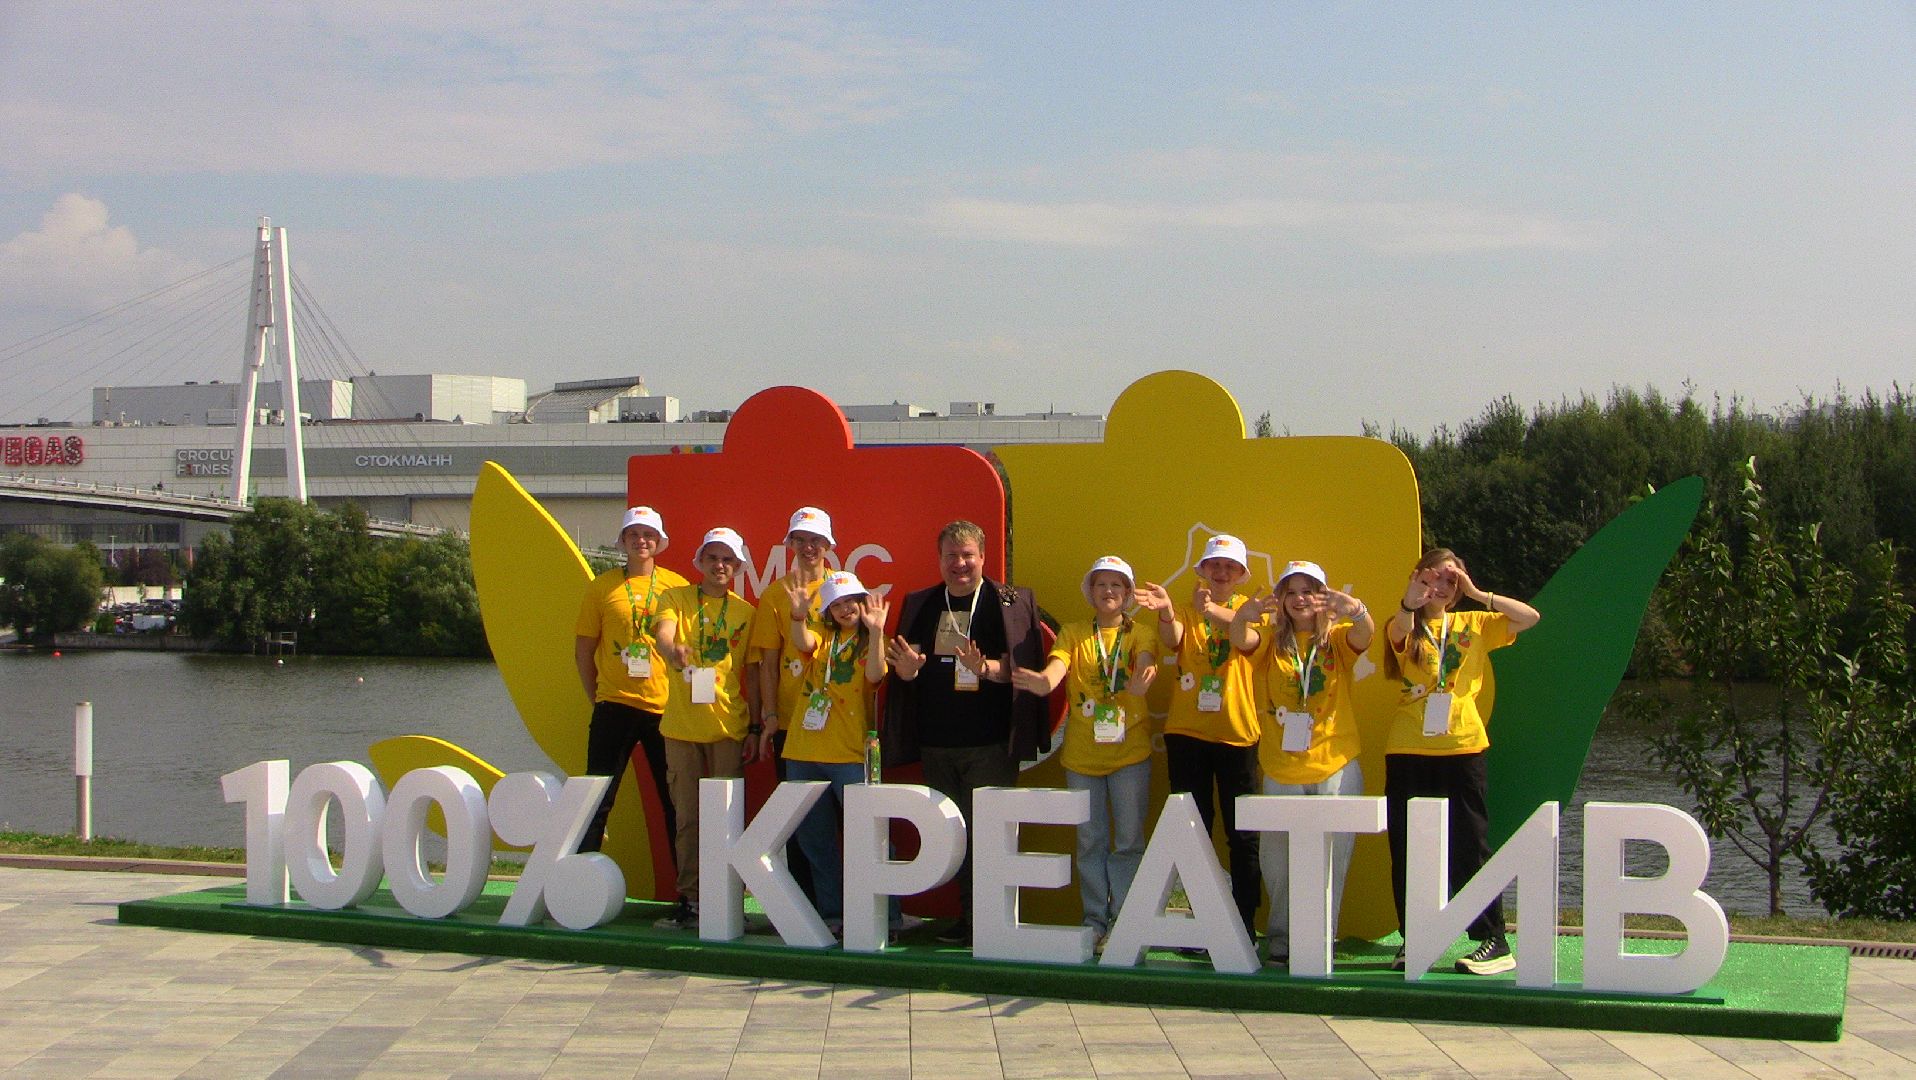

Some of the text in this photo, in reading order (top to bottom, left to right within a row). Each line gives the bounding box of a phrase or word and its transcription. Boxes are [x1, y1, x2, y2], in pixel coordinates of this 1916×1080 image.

[355, 454, 453, 467] СТОКМАНН
[221, 758, 1730, 995] 100% КРЕАТИВ
